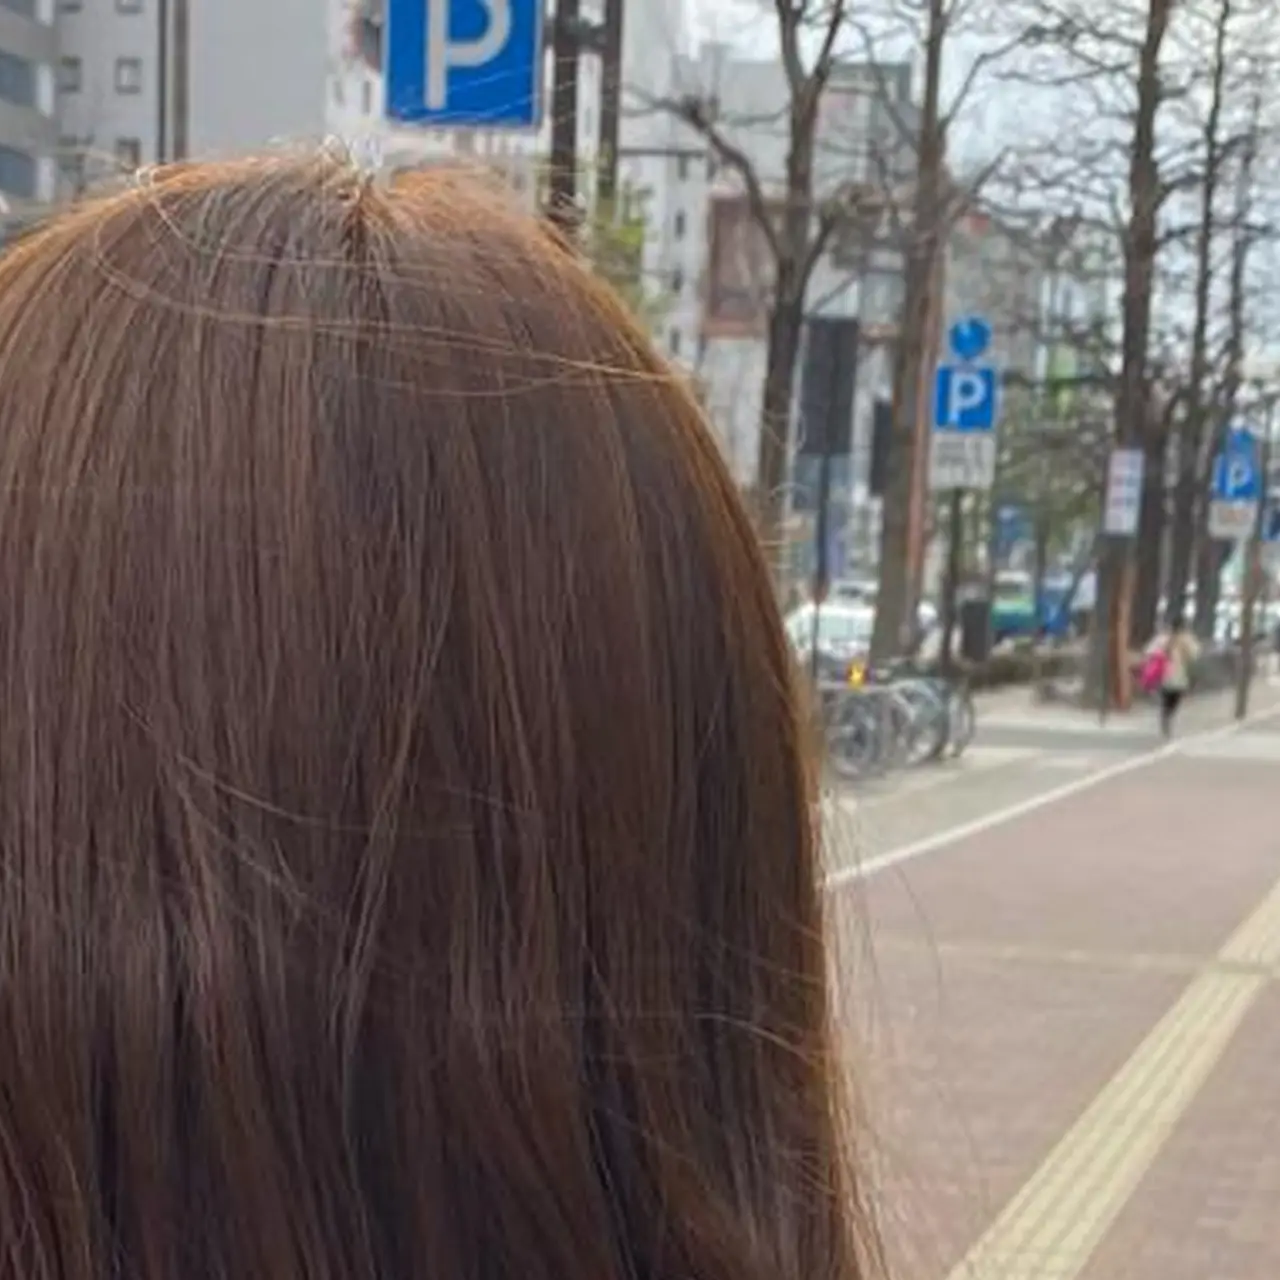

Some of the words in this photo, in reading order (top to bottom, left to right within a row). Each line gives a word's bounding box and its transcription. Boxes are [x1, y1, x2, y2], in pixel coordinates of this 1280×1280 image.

[425, 0, 512, 110] P
[947, 370, 987, 423] P
[1225, 459, 1253, 497] P
